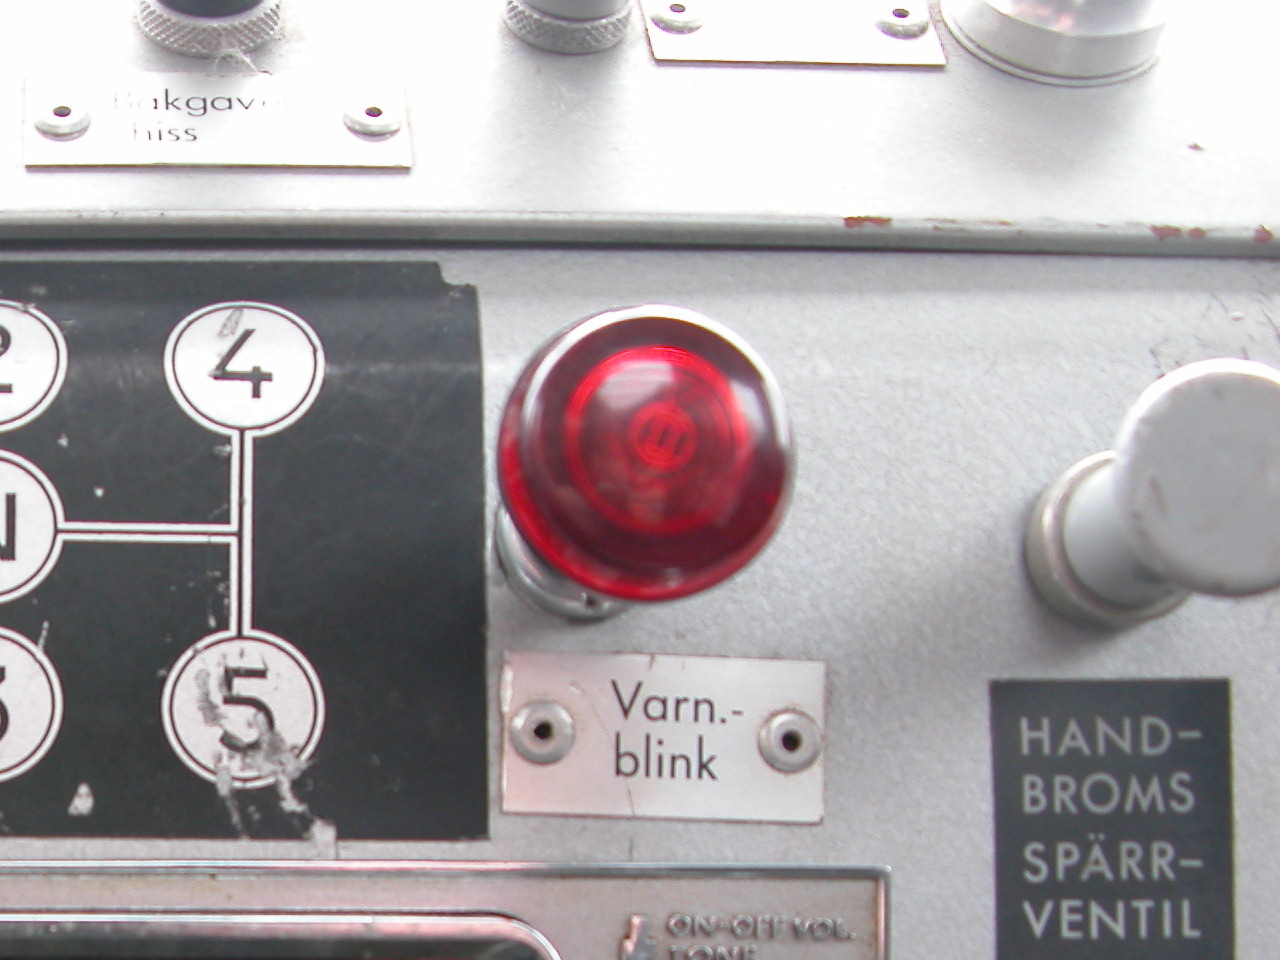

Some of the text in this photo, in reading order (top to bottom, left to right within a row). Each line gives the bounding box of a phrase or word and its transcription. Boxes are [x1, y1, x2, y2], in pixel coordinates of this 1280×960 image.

[213, 328, 273, 399] 4
[220, 666, 275, 751] 5
[611, 679, 744, 724] Varn.-
[614, 731, 718, 781] blink
[1020, 715, 1202, 757] HAND-
[1022, 772, 1196, 815] BROMS
[1022, 832, 1203, 884] SPÄRR-
[667, 913, 786, 939] ON-OFF
[1021, 899, 1202, 940] VENTIL
